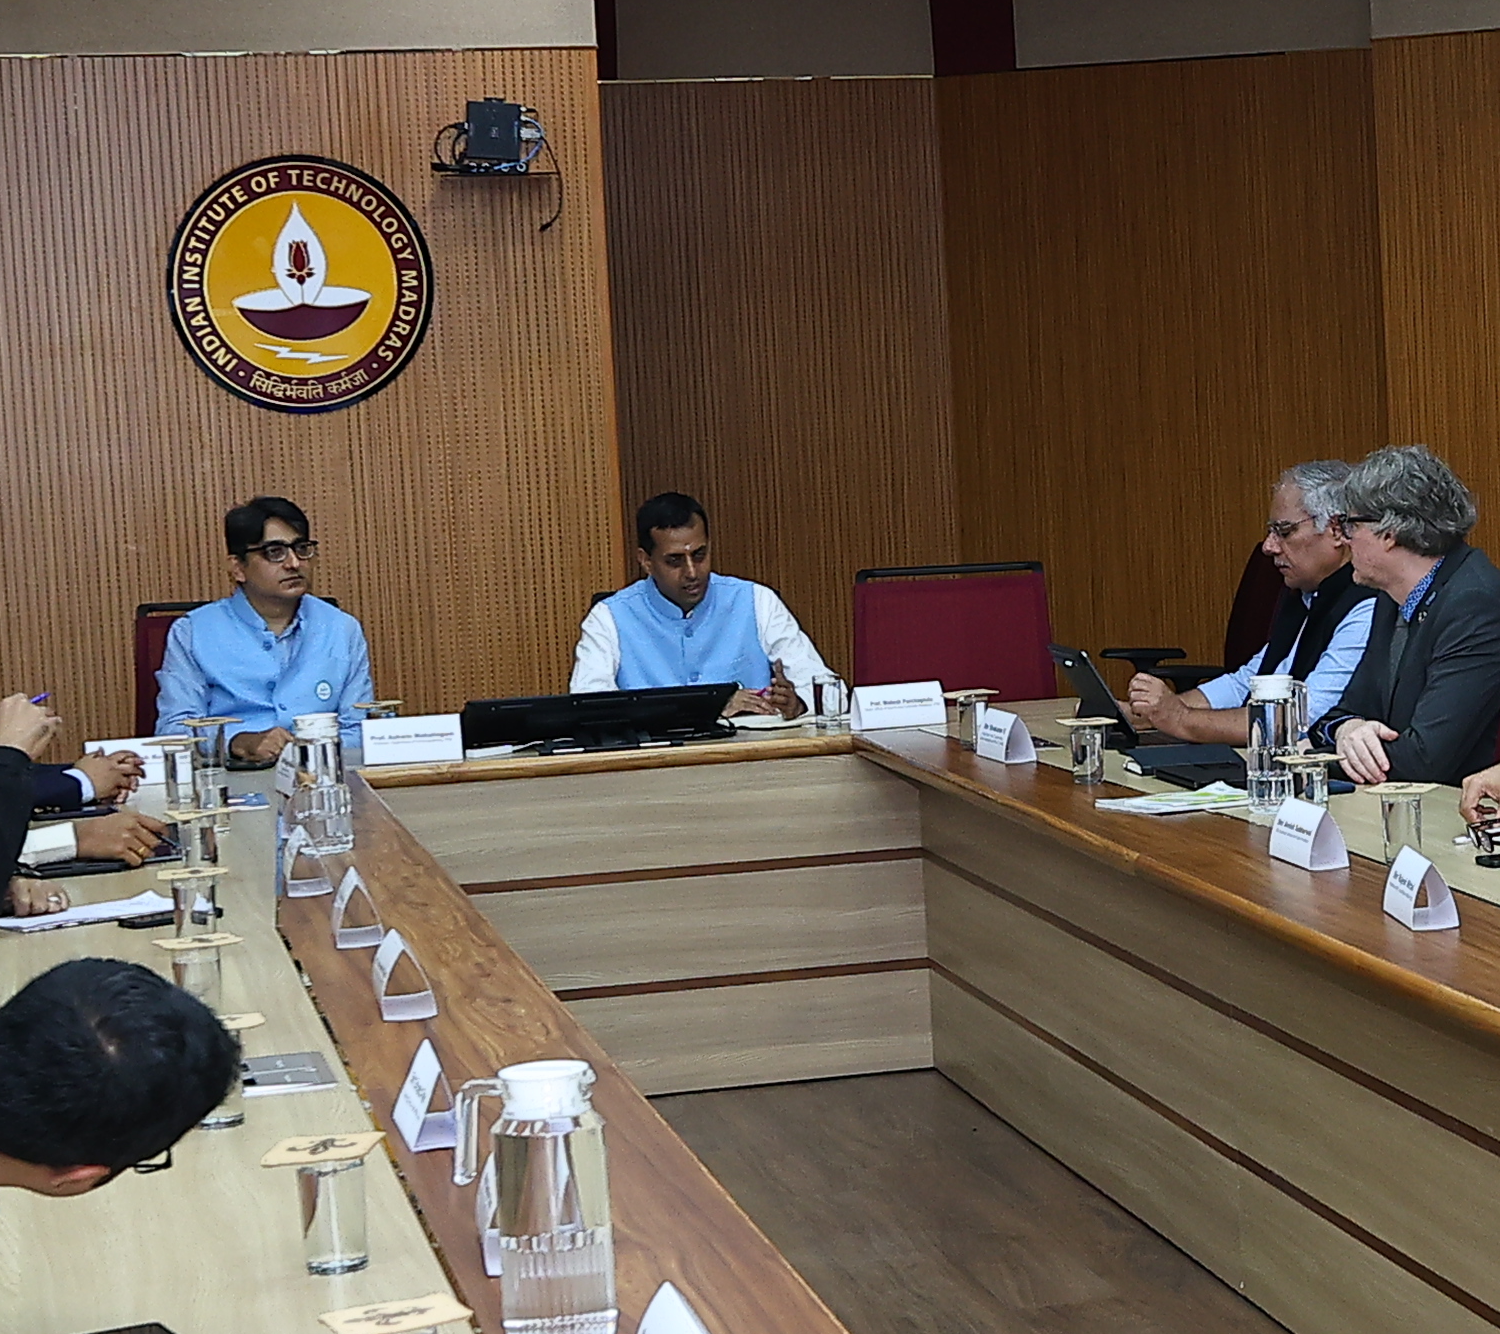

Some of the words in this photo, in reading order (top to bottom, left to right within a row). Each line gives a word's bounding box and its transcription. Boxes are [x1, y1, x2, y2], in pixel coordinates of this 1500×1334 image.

[250, 170, 280, 194] OF
[286, 169, 415, 261] TECHNOLOGY
[181, 185, 248, 290] INSTITUTE
[182, 293, 238, 373] INDIAN
[380, 269, 418, 363] MADRAS
